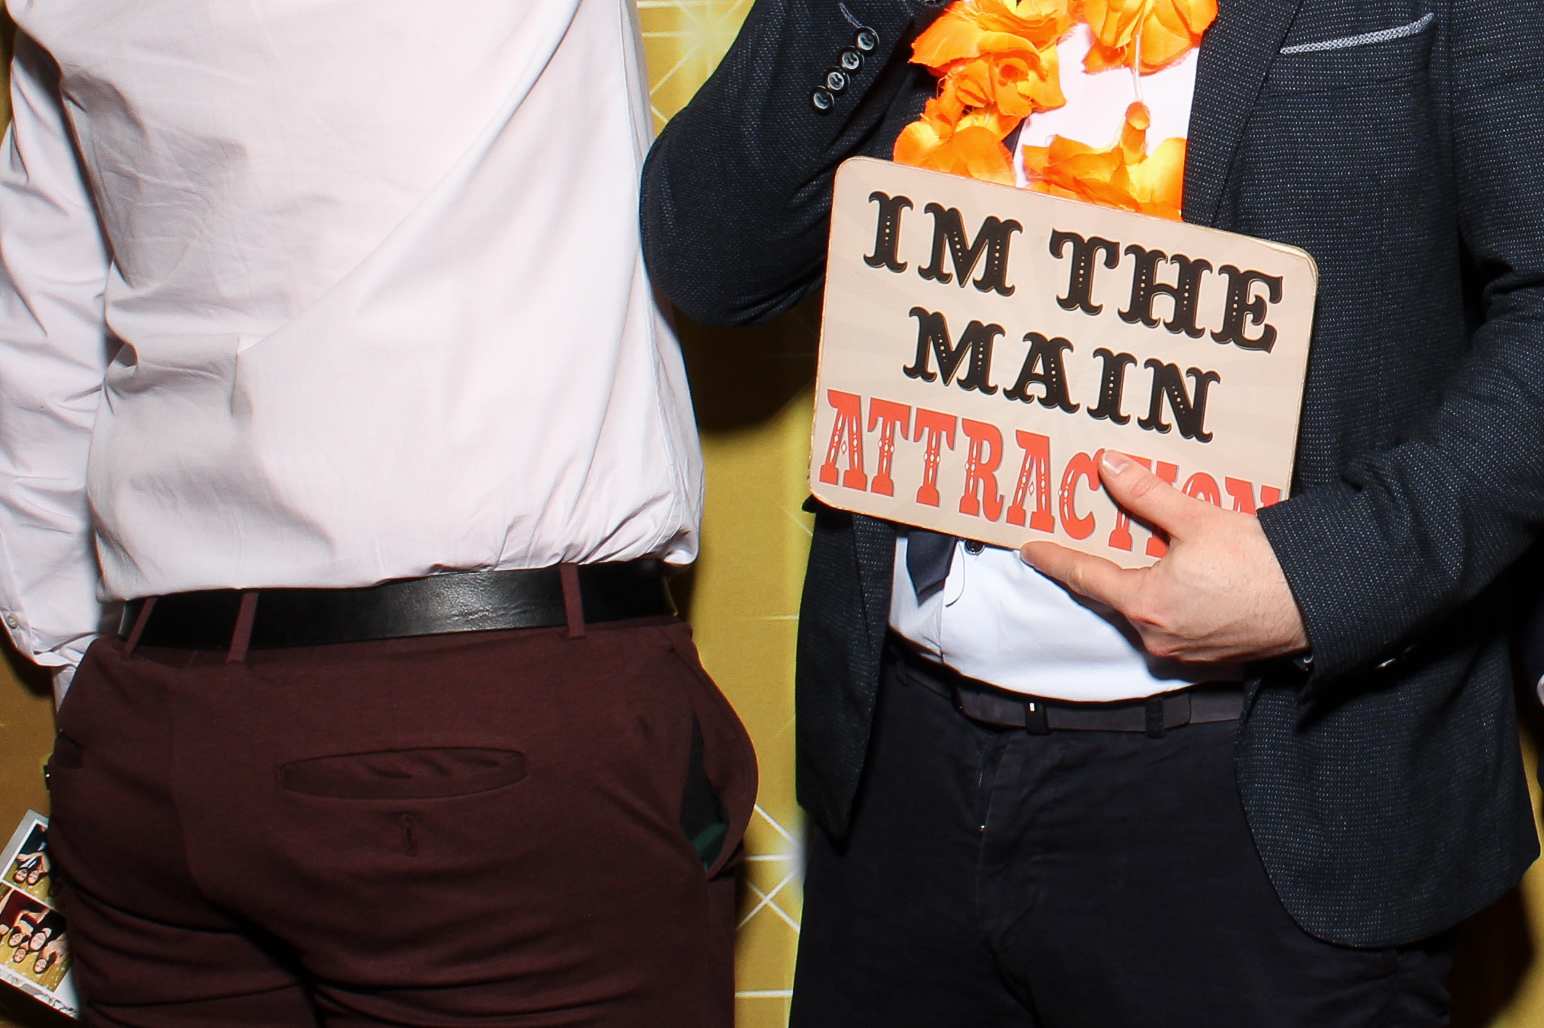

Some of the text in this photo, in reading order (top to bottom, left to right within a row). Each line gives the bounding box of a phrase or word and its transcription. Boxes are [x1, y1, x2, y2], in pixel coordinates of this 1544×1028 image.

[863, 191, 1283, 354] IM THE
[902, 306, 1221, 444] MAIN
